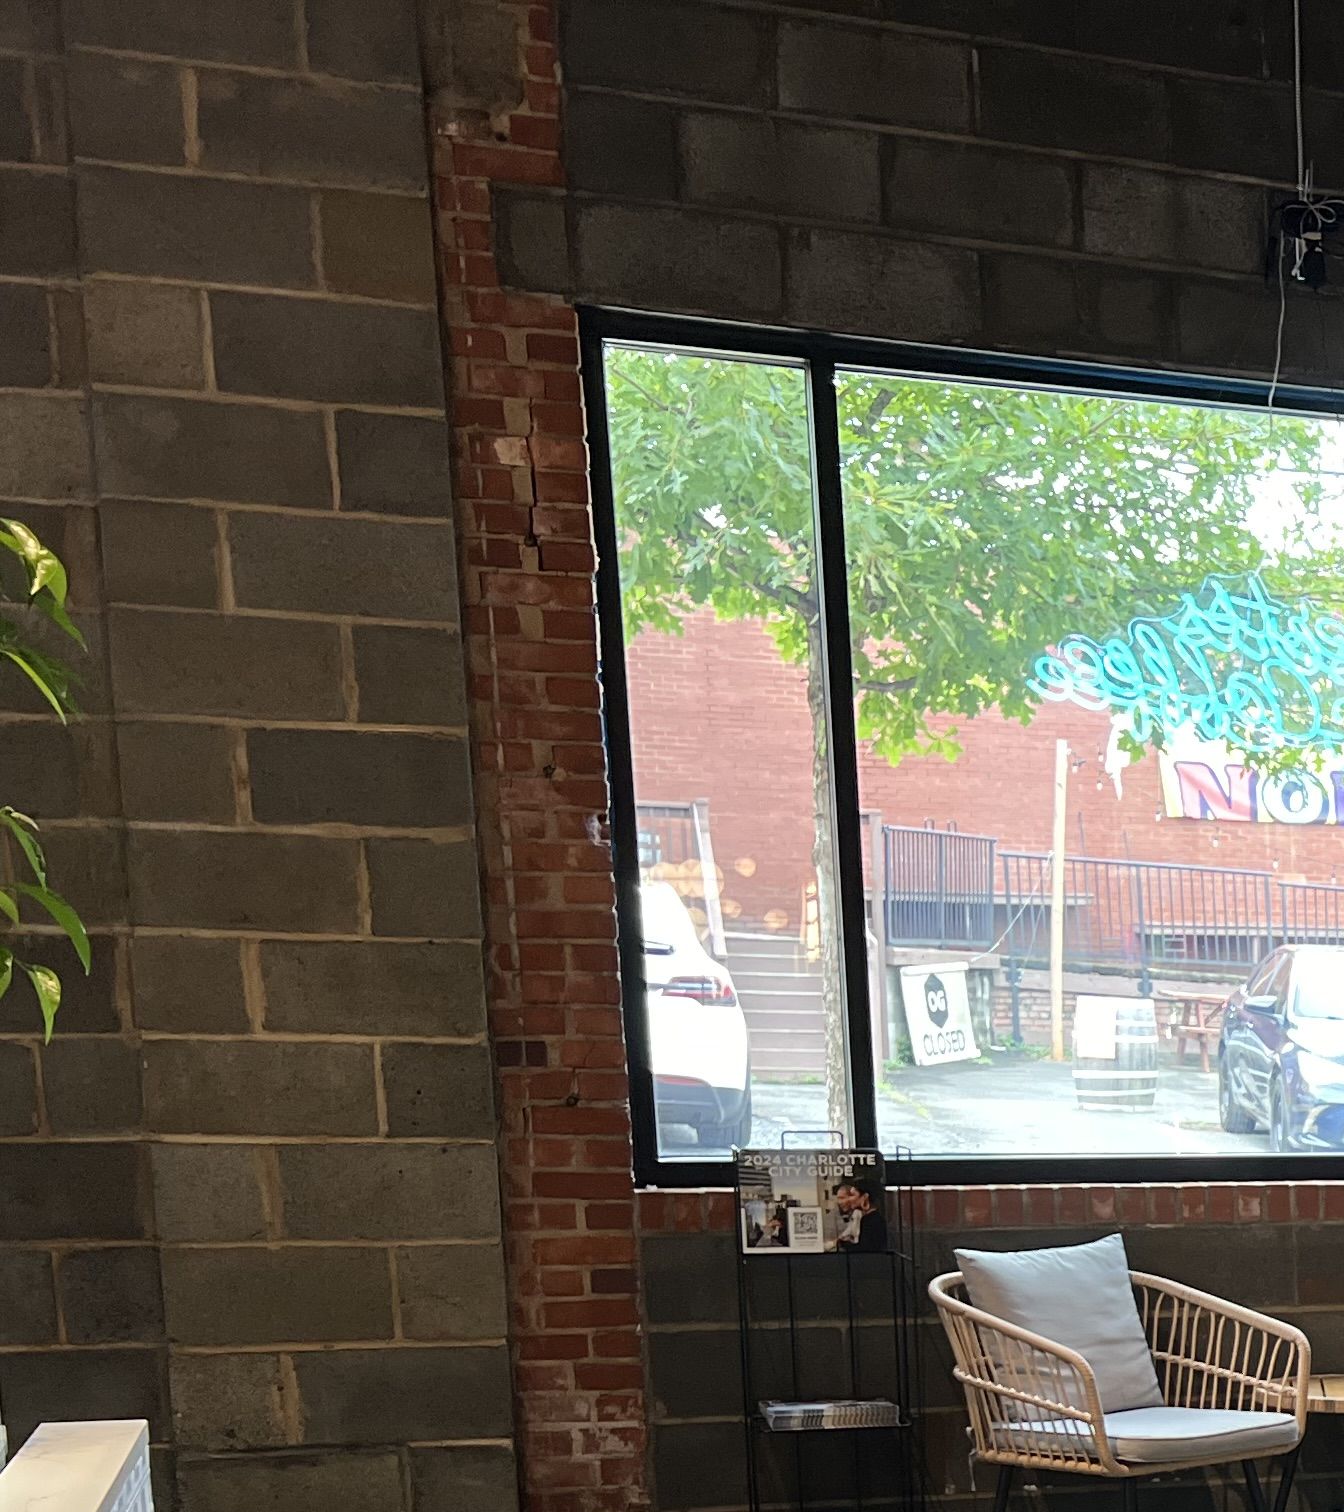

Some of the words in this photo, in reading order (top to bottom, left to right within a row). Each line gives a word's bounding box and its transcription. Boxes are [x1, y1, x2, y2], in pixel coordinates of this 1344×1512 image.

[927, 990, 947, 1013] OG
[923, 1029, 966, 1057] CLOSED
[743, 1155, 783, 1167] 2024
[785, 1153, 876, 1167] CHARLOTTE
[768, 1166, 805, 1177] CITY
[807, 1165, 854, 1177] GUIDE
